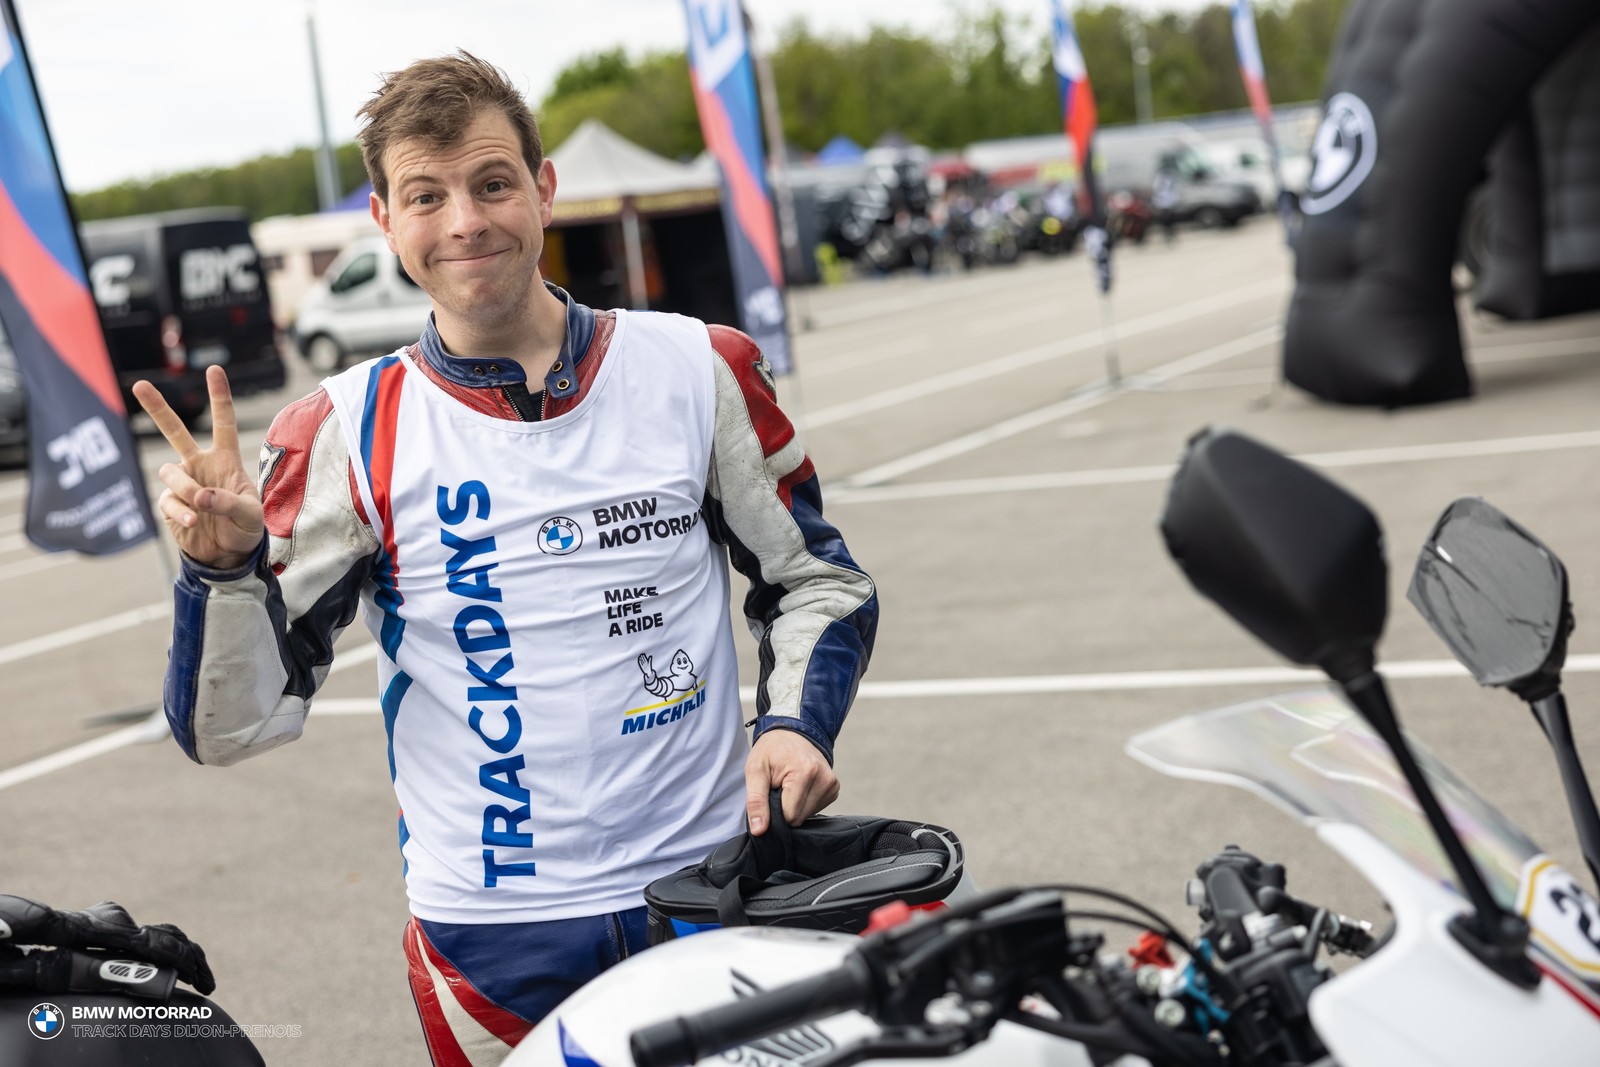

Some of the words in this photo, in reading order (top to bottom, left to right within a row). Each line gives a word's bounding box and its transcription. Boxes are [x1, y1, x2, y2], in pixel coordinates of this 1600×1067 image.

[592, 497, 657, 526] BMW
[541, 518, 574, 534] BMW
[604, 586, 659, 604] MAKE
[607, 601, 643, 620] LIFE
[609, 622, 623, 638] A
[626, 612, 664, 634] RIDE
[437, 479, 536, 888] TRACKDAYS
